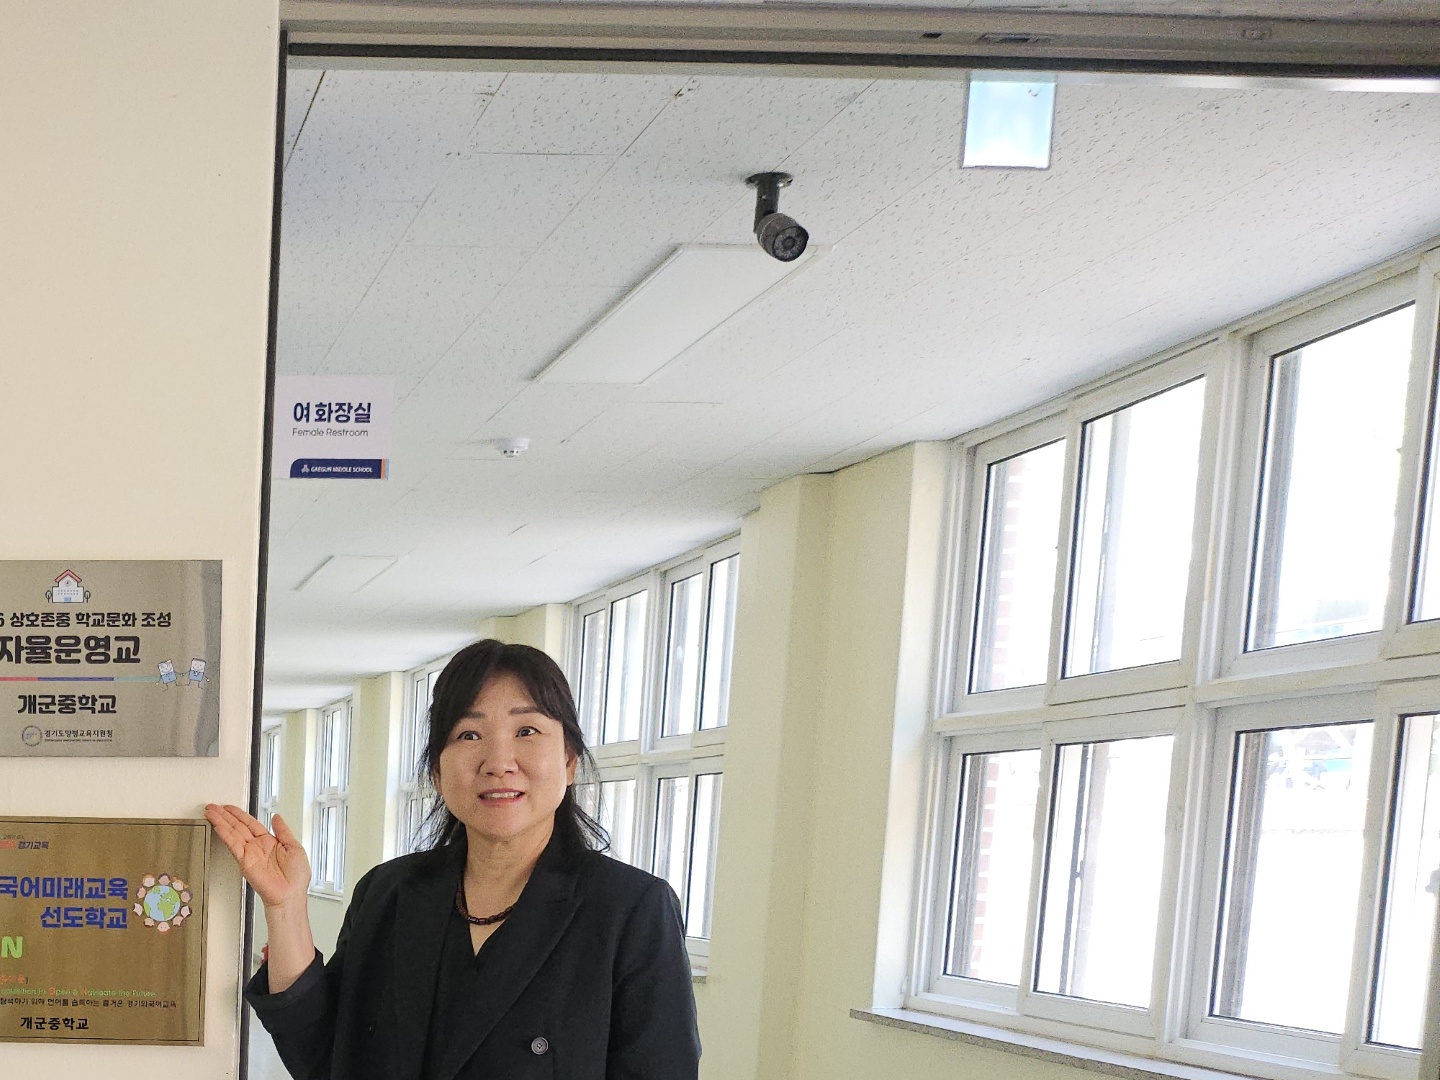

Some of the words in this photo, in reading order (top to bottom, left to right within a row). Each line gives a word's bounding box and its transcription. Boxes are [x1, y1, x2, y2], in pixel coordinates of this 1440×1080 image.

[292, 428, 324, 437] Female
[326, 428, 368, 437] Restroom
[10, 612, 71, 627] 상호존중
[75, 612, 137, 627] 학교문화
[141, 612, 172, 627] 조성
[17, 694, 117, 714] 개군중학교
[40, 906, 128, 929] 선도학교
[20, 1016, 89, 1031] 개군중학교
